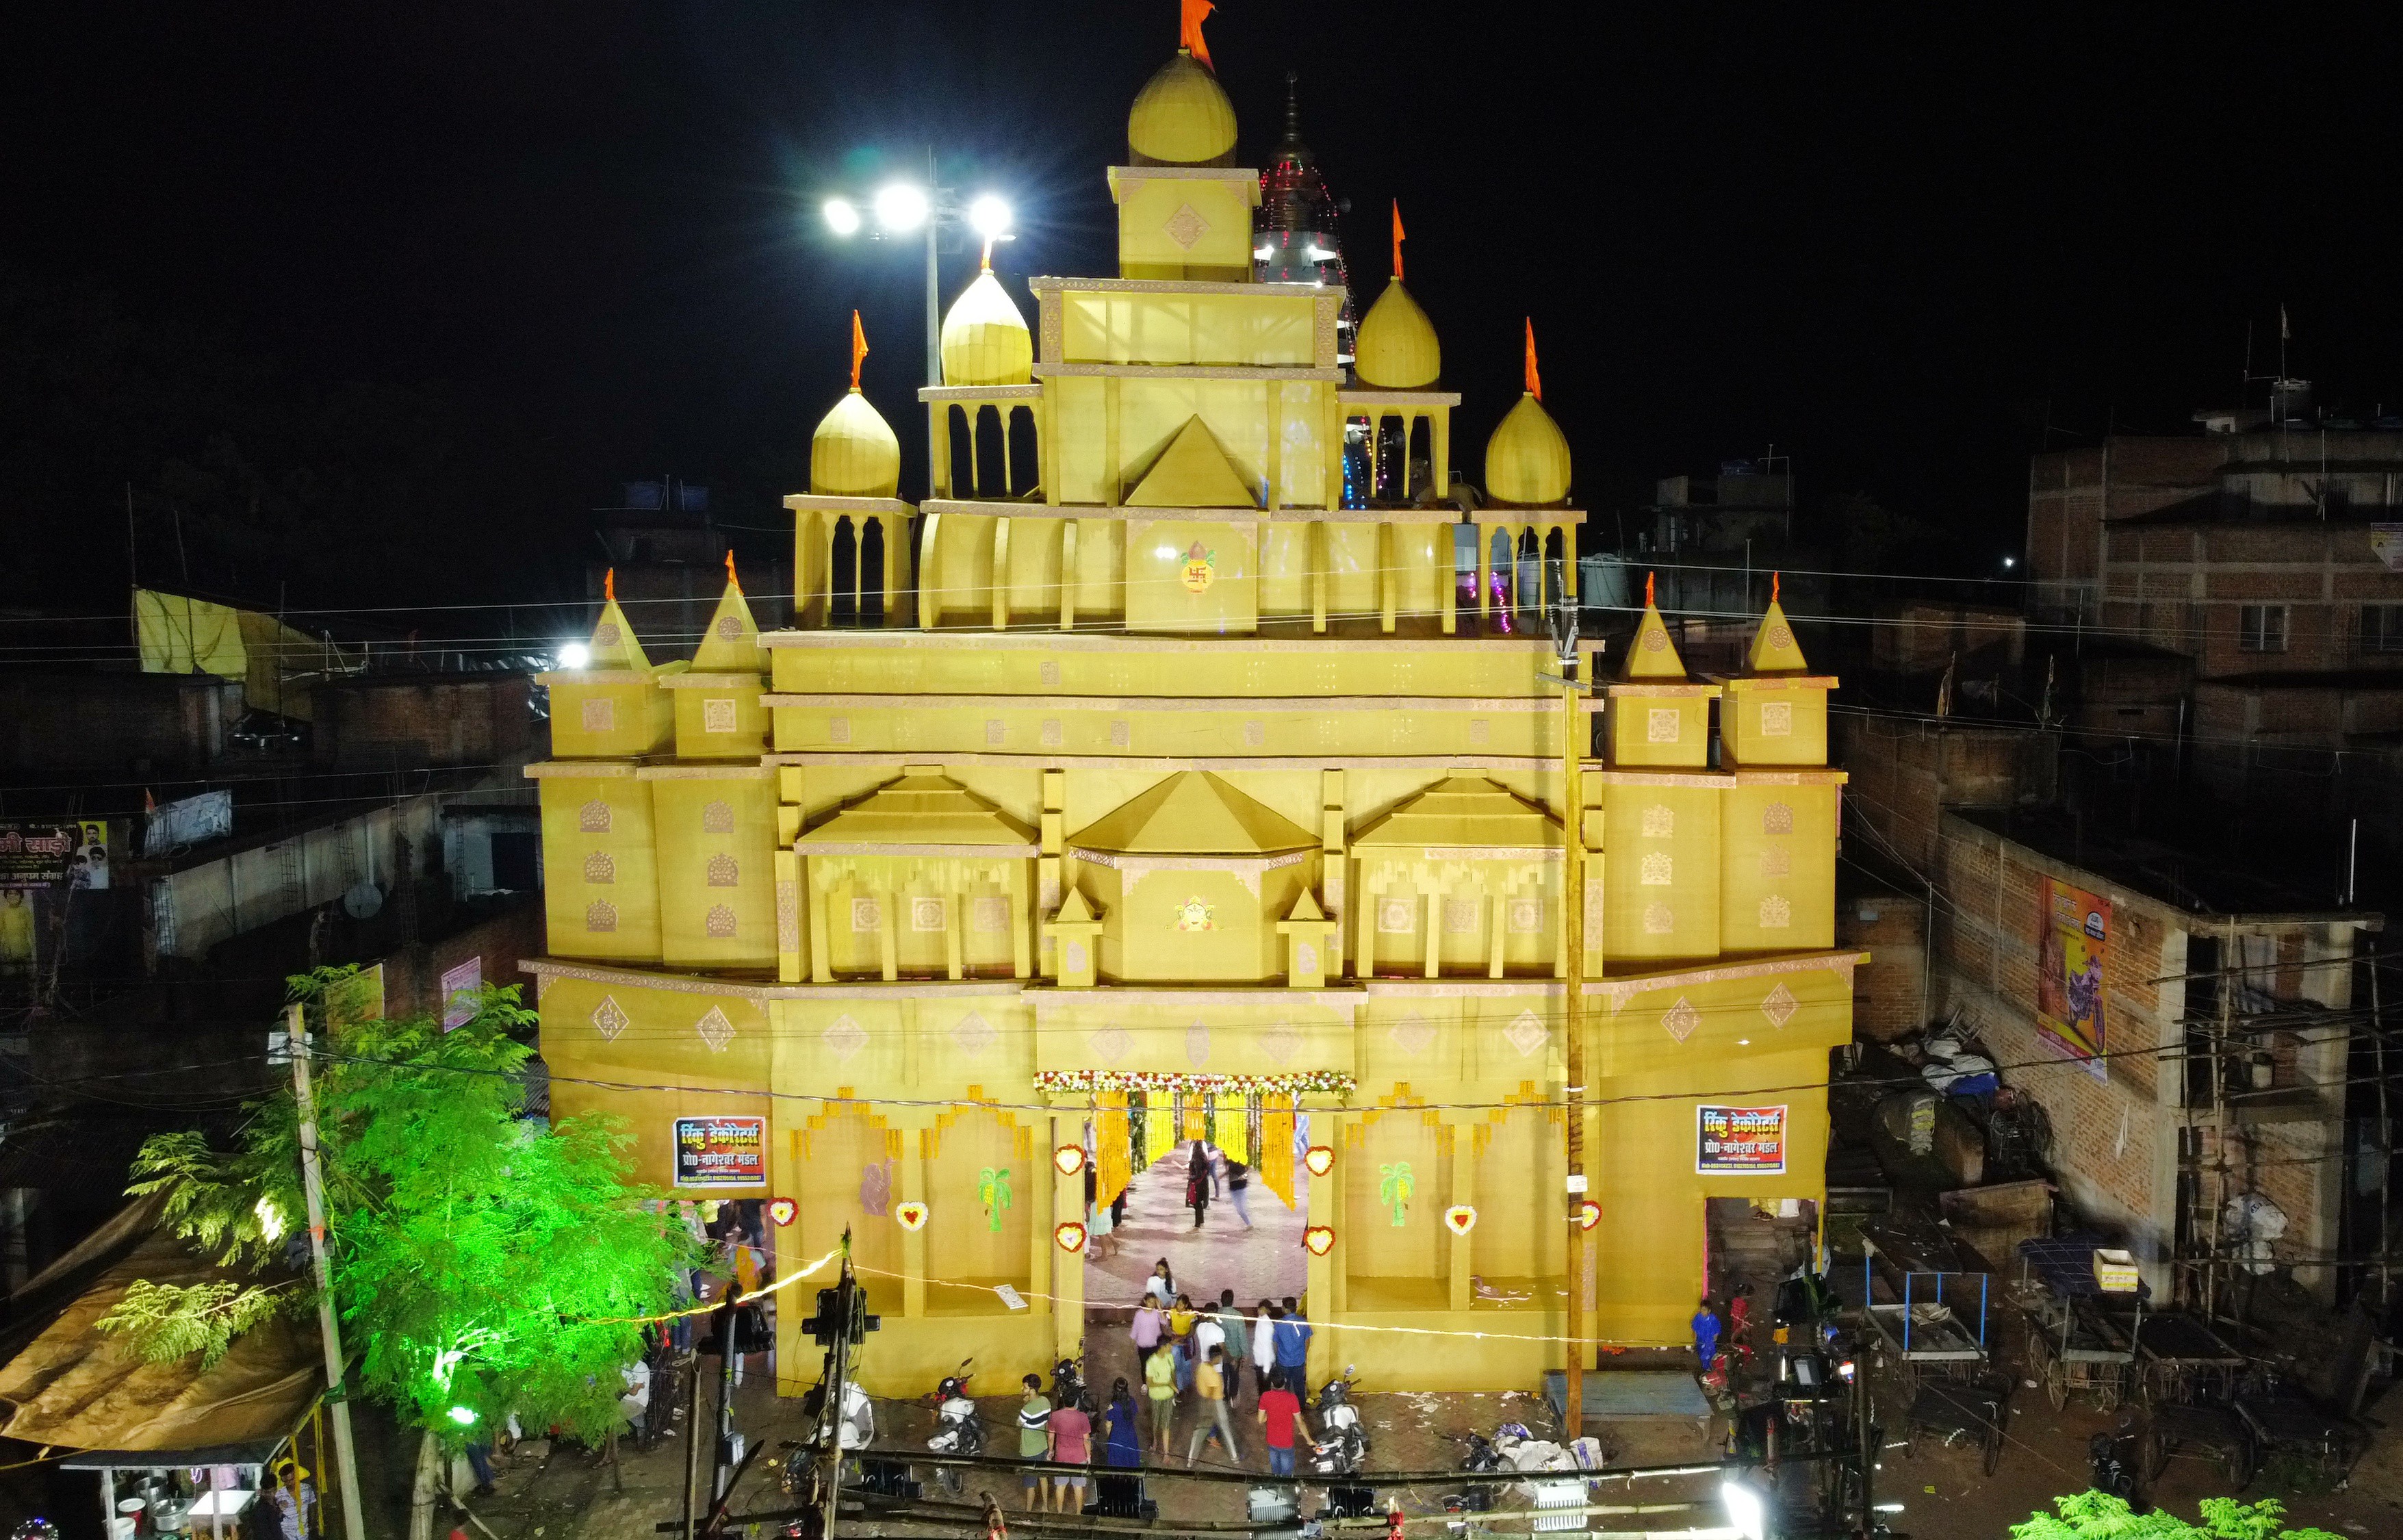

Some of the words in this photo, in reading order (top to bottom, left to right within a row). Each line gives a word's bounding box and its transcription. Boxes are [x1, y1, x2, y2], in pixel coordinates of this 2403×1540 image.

[1704, 1111, 1728, 1138] रिंकु
[1731, 1112, 1780, 1133] डेकोरेटर्स
[680, 1123, 706, 1150] रिंकु
[708, 1122, 759, 1144] डेकोरेटर्स
[1758, 1139, 1778, 1153] मंडल
[738, 1151, 759, 1166] मंडल
